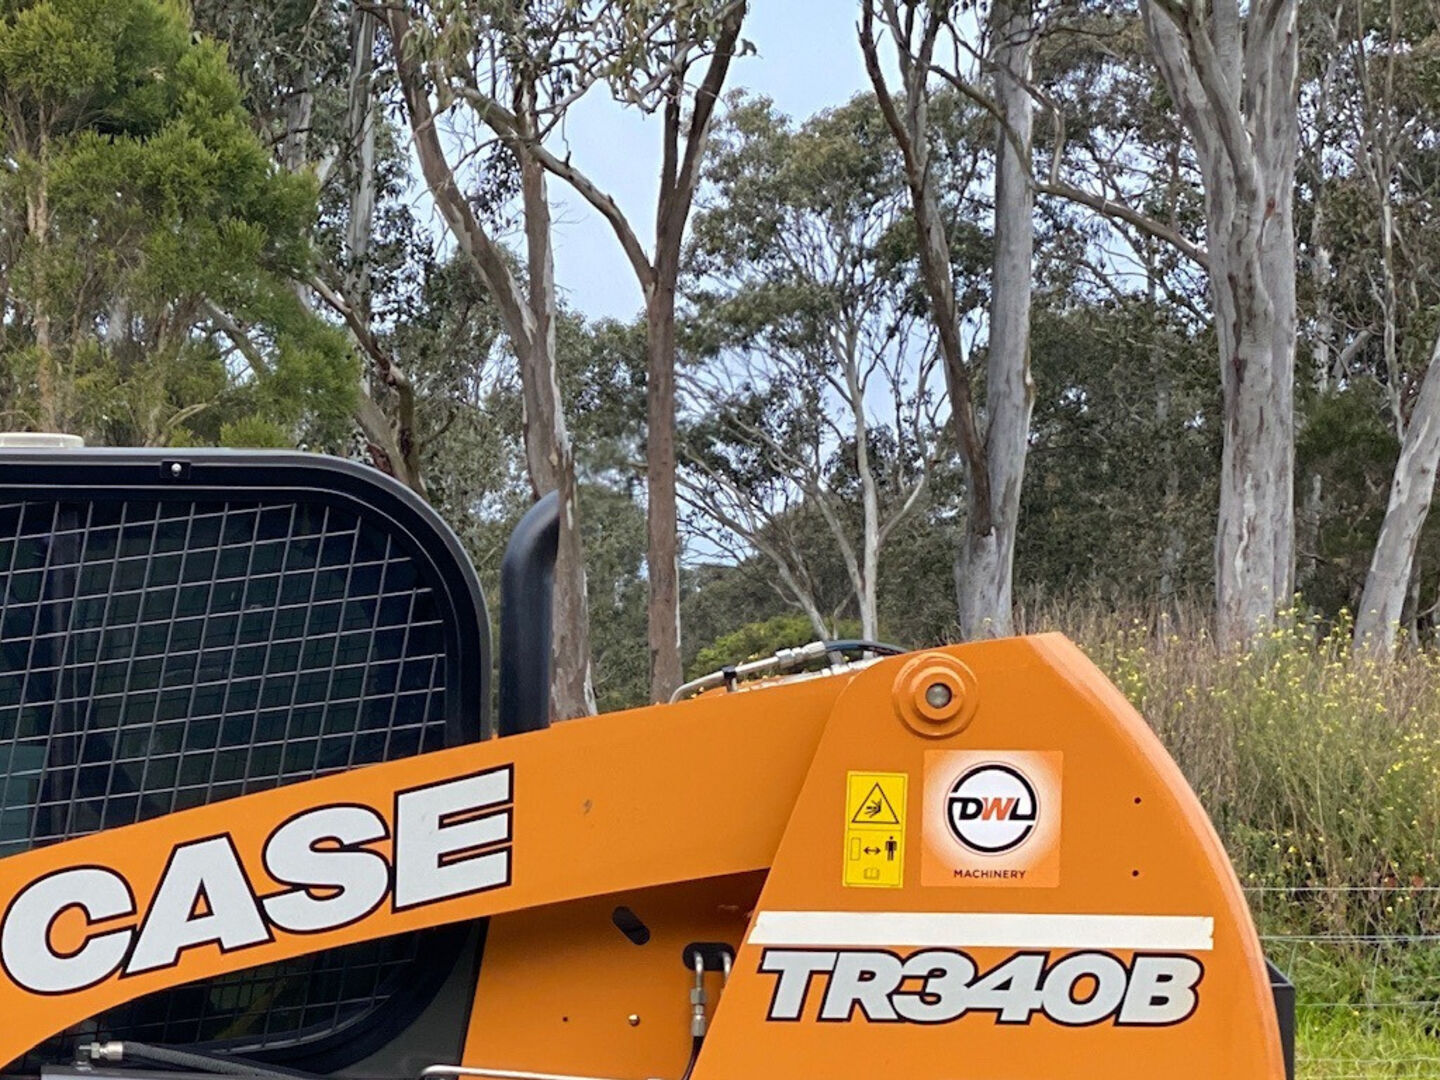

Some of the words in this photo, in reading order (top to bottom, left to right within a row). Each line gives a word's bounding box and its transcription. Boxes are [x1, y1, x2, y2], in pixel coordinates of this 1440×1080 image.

[948, 797, 1037, 821] DWL
[953, 869, 1027, 879] MACHINERY
[758, 947, 1205, 1027] TR340B
